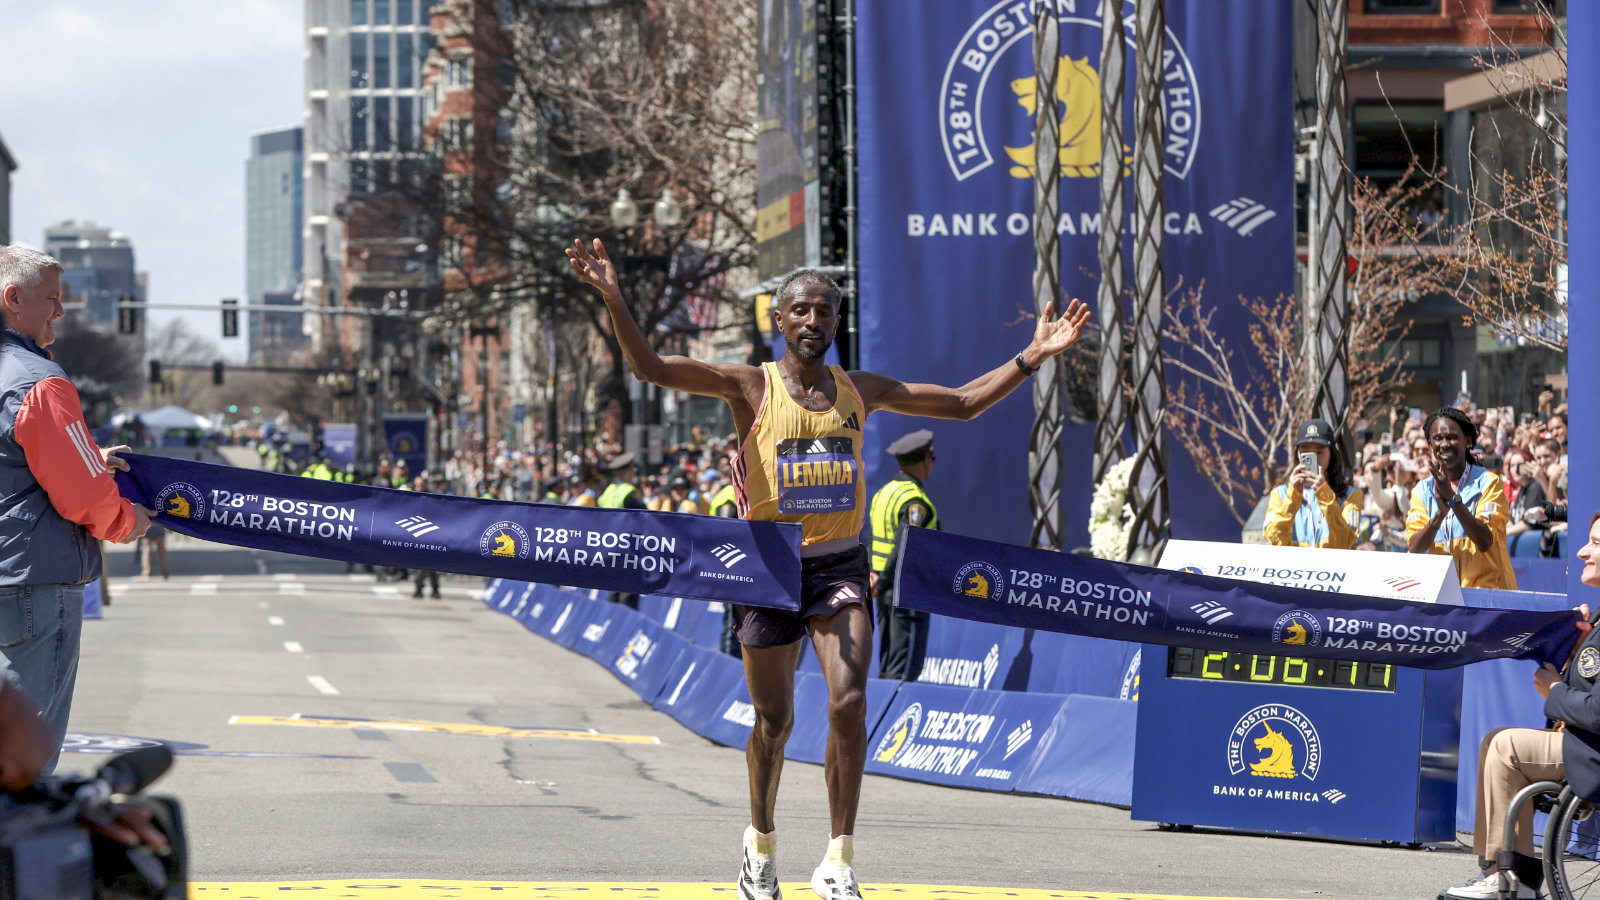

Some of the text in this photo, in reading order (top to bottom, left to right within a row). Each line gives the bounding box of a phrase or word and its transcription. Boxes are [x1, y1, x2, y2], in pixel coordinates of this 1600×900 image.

[950, 81, 979, 165] 128TH
[907, 212, 1203, 236] BANK O AMCA
[782, 460, 853, 488] LEMMA
[211, 489, 356, 522] 128TH BOSTON
[209, 509, 354, 541] MARATHON
[485, 522, 509, 537] BOSTON
[382, 539, 403, 547] BANK
[414, 543, 447, 552] AMERICA
[534, 526, 677, 554] 128TH BOSTON
[534, 547, 675, 574] MARATHON
[959, 562, 983, 576] BOSTON
[726, 574, 754, 583] AMERICA
[1009, 568, 1152, 607] 128TH BOSTON
[1262, 567, 1346, 582] BOSTON
[1006, 588, 1150, 626] MARATHON
[1277, 611, 1301, 626] BOSTON
[1207, 631, 1239, 639] AMERICA
[1326, 616, 1467, 645] 128TH BOSTON
[1323, 636, 1460, 655] MARATHON
[919, 710, 949, 739] THE
[1230, 706, 1318, 771] THE BOSTON MARATHON
[895, 743, 976, 775] MARATHON
[1213, 785, 1319, 802] BANK OF AMERICA
